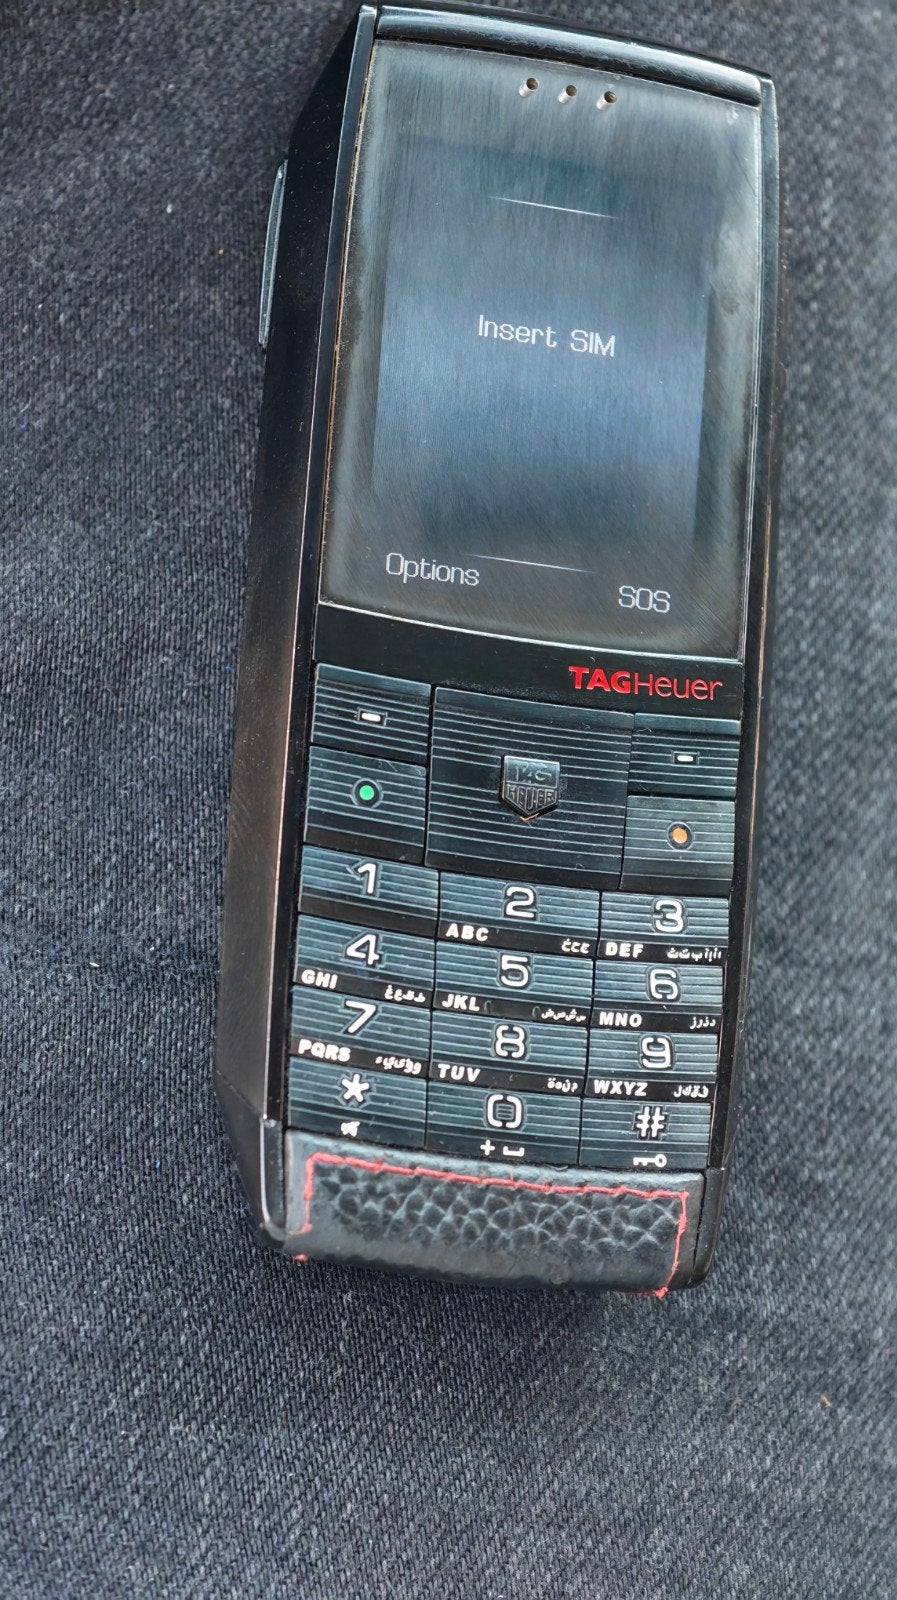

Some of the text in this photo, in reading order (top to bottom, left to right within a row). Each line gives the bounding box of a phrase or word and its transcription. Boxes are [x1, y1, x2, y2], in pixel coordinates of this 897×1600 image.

[477, 314, 616, 358] Insert SIM
[385, 552, 480, 587] Options
[618, 585, 671, 614] SOS
[351, 862, 378, 895] 1
[504, 886, 536, 919] 2
[653, 900, 684, 934] 3
[445, 923, 489, 942] ABC
[346, 934, 380, 966] 4
[605, 941, 645, 960] DEF
[301, 969, 338, 990] GHI
[500, 955, 530, 987] 5
[648, 968, 680, 1001] 6
[345, 1000, 377, 1034] 7
[441, 993, 480, 1012] JKL
[598, 1011, 643, 1029] MNO
[297, 1039, 351, 1063] PQRS
[494, 1024, 526, 1059] 8
[641, 1037, 672, 1070] 9
[437, 1063, 481, 1083] TUV
[593, 1079, 648, 1097] WXYZ
